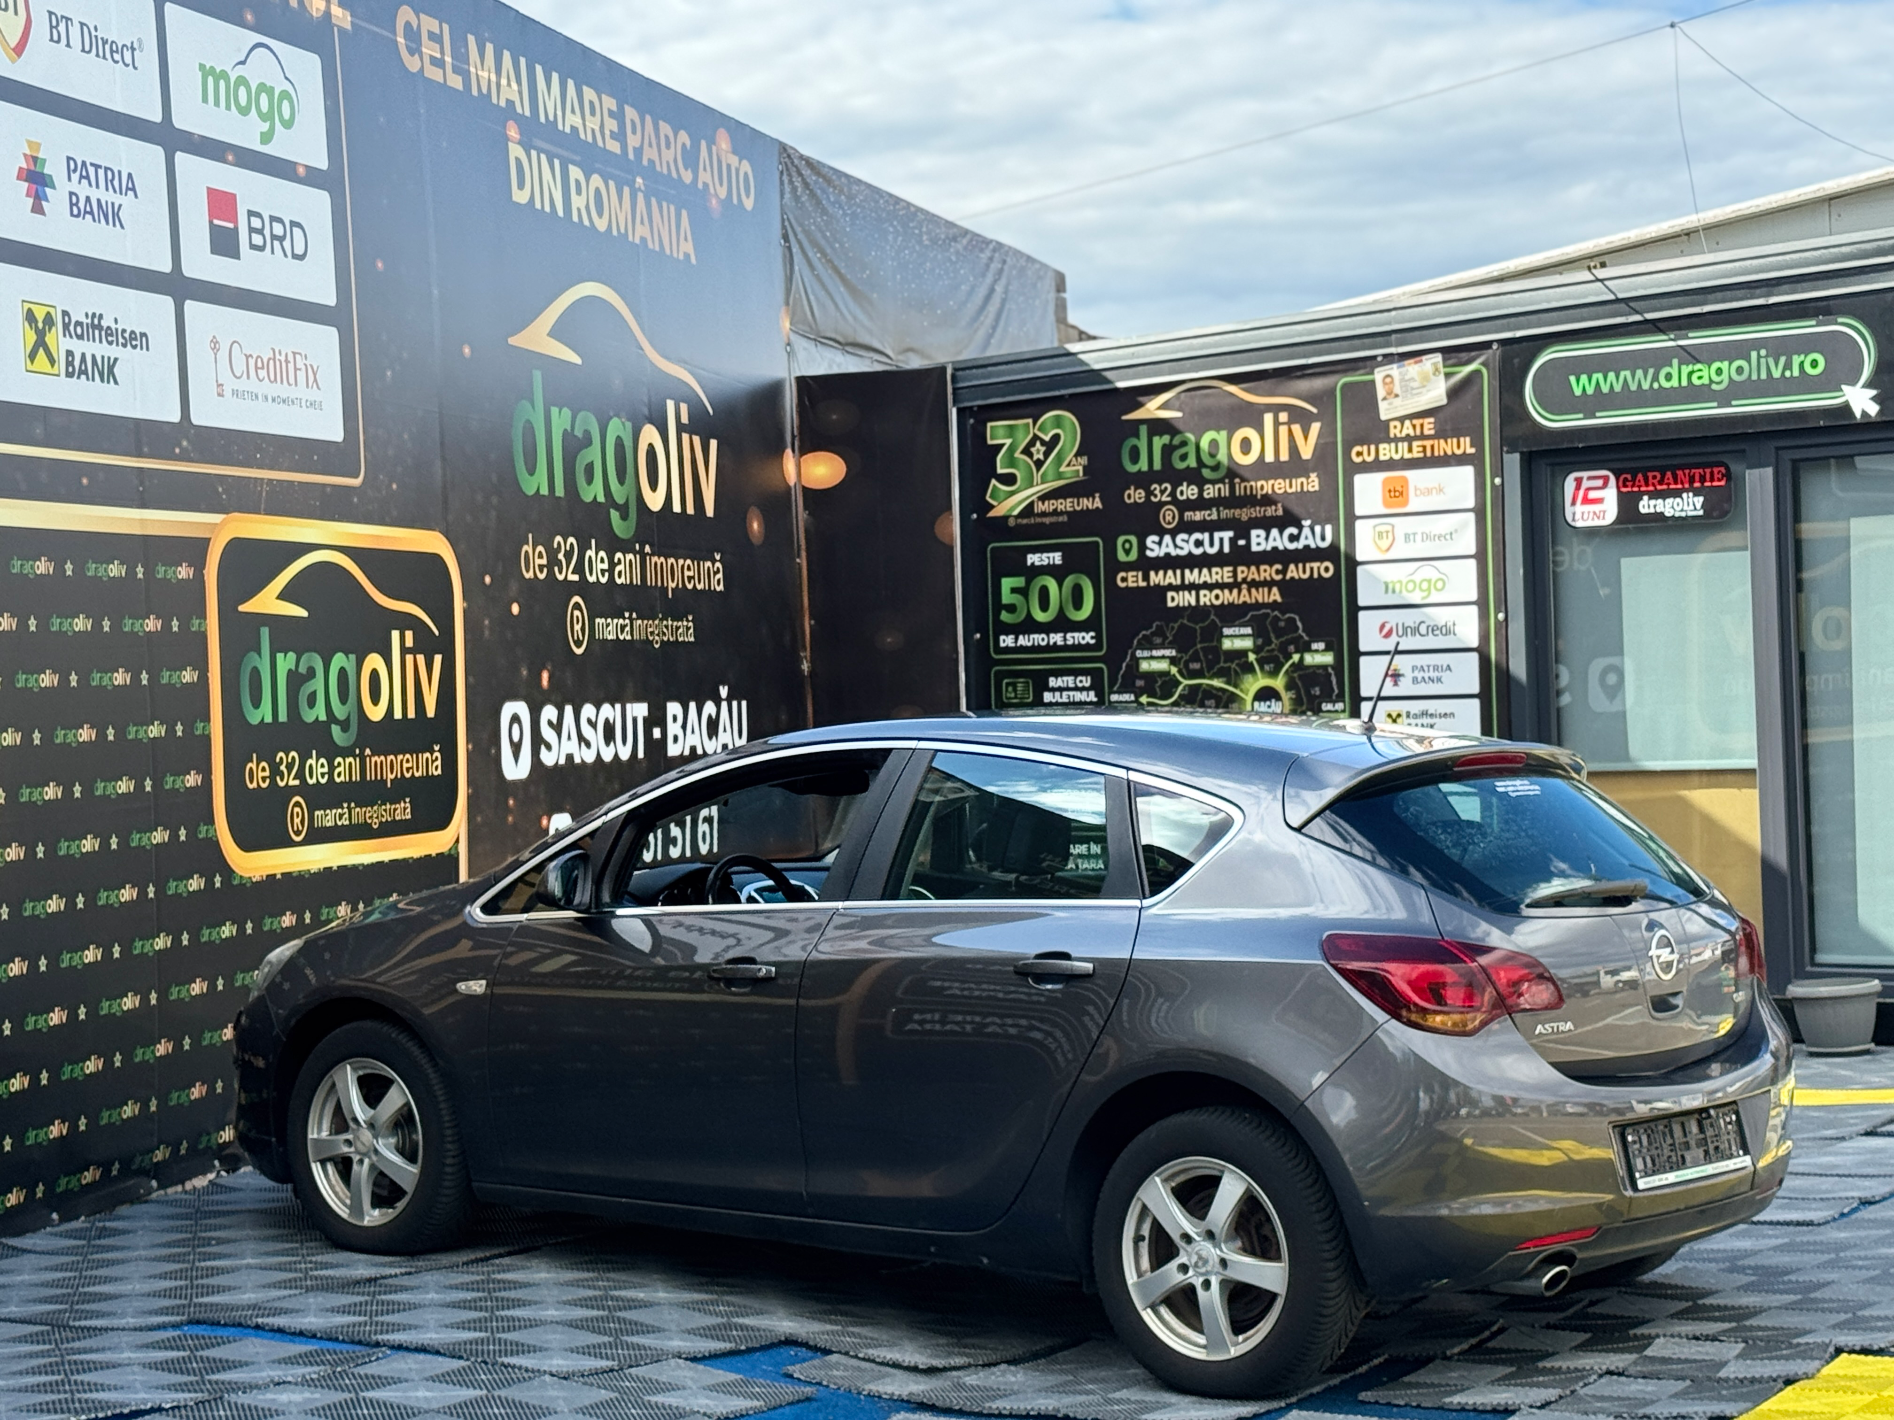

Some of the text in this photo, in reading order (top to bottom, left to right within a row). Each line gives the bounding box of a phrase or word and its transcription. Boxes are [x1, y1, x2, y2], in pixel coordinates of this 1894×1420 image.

[46, 9, 73, 49] BT
[199, 62, 296, 145] mogo
[395, 5, 755, 212] CEL MAI MARE PARC AUTO
[66, 155, 138, 199] PATRIA
[68, 190, 125, 230] BANK
[507, 140, 697, 265] DIN ROMÂNIA
[247, 209, 308, 262] BRD
[61, 309, 150, 352] Raiffeisen
[65, 349, 120, 386] BANK
[228, 340, 321, 391] CreditFix
[1569, 349, 1826, 397] www.dragoliv.ro
[231, 388, 259, 402] PRIETEN
[271, 395, 303, 409] MOMENTE
[1389, 417, 1435, 438] RATE
[511, 369, 718, 540] dragoliv
[1121, 411, 1321, 480] dragoliv
[1351, 436, 1476, 463] CU BULETINUL
[1124, 472, 1319, 504] de 32 de ani împreună
[1387, 483, 1446, 499] tbi bank
[1570, 474, 1609, 507] 12
[1618, 466, 1727, 492] GARANTIE
[1184, 507, 1218, 522] marcă
[1219, 503, 1283, 522] înregistrată
[1571, 509, 1607, 523] LUNI
[1639, 492, 1704, 517] dragoliv
[1145, 530, 1234, 558] SASCUT
[1250, 519, 1332, 552] BACĂU
[1377, 530, 1391, 541] BT
[1404, 532, 1418, 544] BT
[10, 556, 194, 583] dragoliv dragoliv dragoliv
[521, 533, 725, 598] de 32 de ani împreună
[1027, 552, 1063, 566] PESTE
[1116, 561, 1334, 588] CEL MAI MARE PARC AUTO
[1000, 573, 1095, 624] 500
[1167, 583, 1282, 607] DIN ROMÂNIA
[1383, 577, 1447, 601] mogo
[50, 613, 93, 636] dragoliv
[122, 614, 162, 636] dragoliv
[595, 611, 631, 642] marcă
[632, 613, 695, 648] înregistrată
[999, 631, 1096, 647] DE AUTO PE STOC
[1396, 620, 1457, 638] UniCredit
[15, 666, 199, 692] dragoliv dragoliv dragoliv
[1049, 676, 1091, 688] RATE CU
[1412, 664, 1452, 674] PATRIA
[1412, 675, 1444, 685] BANK
[240, 626, 443, 747] dragoliv
[1043, 690, 1097, 703] BULETINUL
[539, 702, 649, 766] SASCUT
[666, 685, 748, 758] BACĂU
[1405, 709, 1455, 720] Raiffeisen
[54, 723, 97, 748] dragoliv
[126, 720, 167, 743] dragoliv
[245, 744, 442, 789] de 32 de ani împreună
[19, 770, 203, 805] dragoliv dragoliv dragoliv
[314, 803, 350, 828] marcă
[350, 797, 411, 829] înregistrată
[57, 834, 101, 858] dragoliv
[130, 826, 170, 850] dragoliv
[698, 805, 718, 855] 61
[22, 894, 66, 918] dragoliv
[97, 884, 139, 908] dragoliv
[166, 874, 206, 897] dragoliv
[59, 944, 103, 970] dragoliv
[132, 932, 173, 956] dragoliv
[200, 921, 238, 944] dragoliv
[262, 911, 298, 933] dragoliv
[24, 1007, 68, 1033] dragoliv
[99, 992, 141, 1017] dragoliv
[168, 977, 209, 1001] dragoliv
[1534, 1021, 1575, 1035] ASTRA
[60, 1054, 105, 1082] dragoliv
[133, 1037, 175, 1063] dragoliv
[24, 1081, 208, 1146] dragoliv dragoliv dragoliv
[56, 1166, 103, 1194] dragoliv
